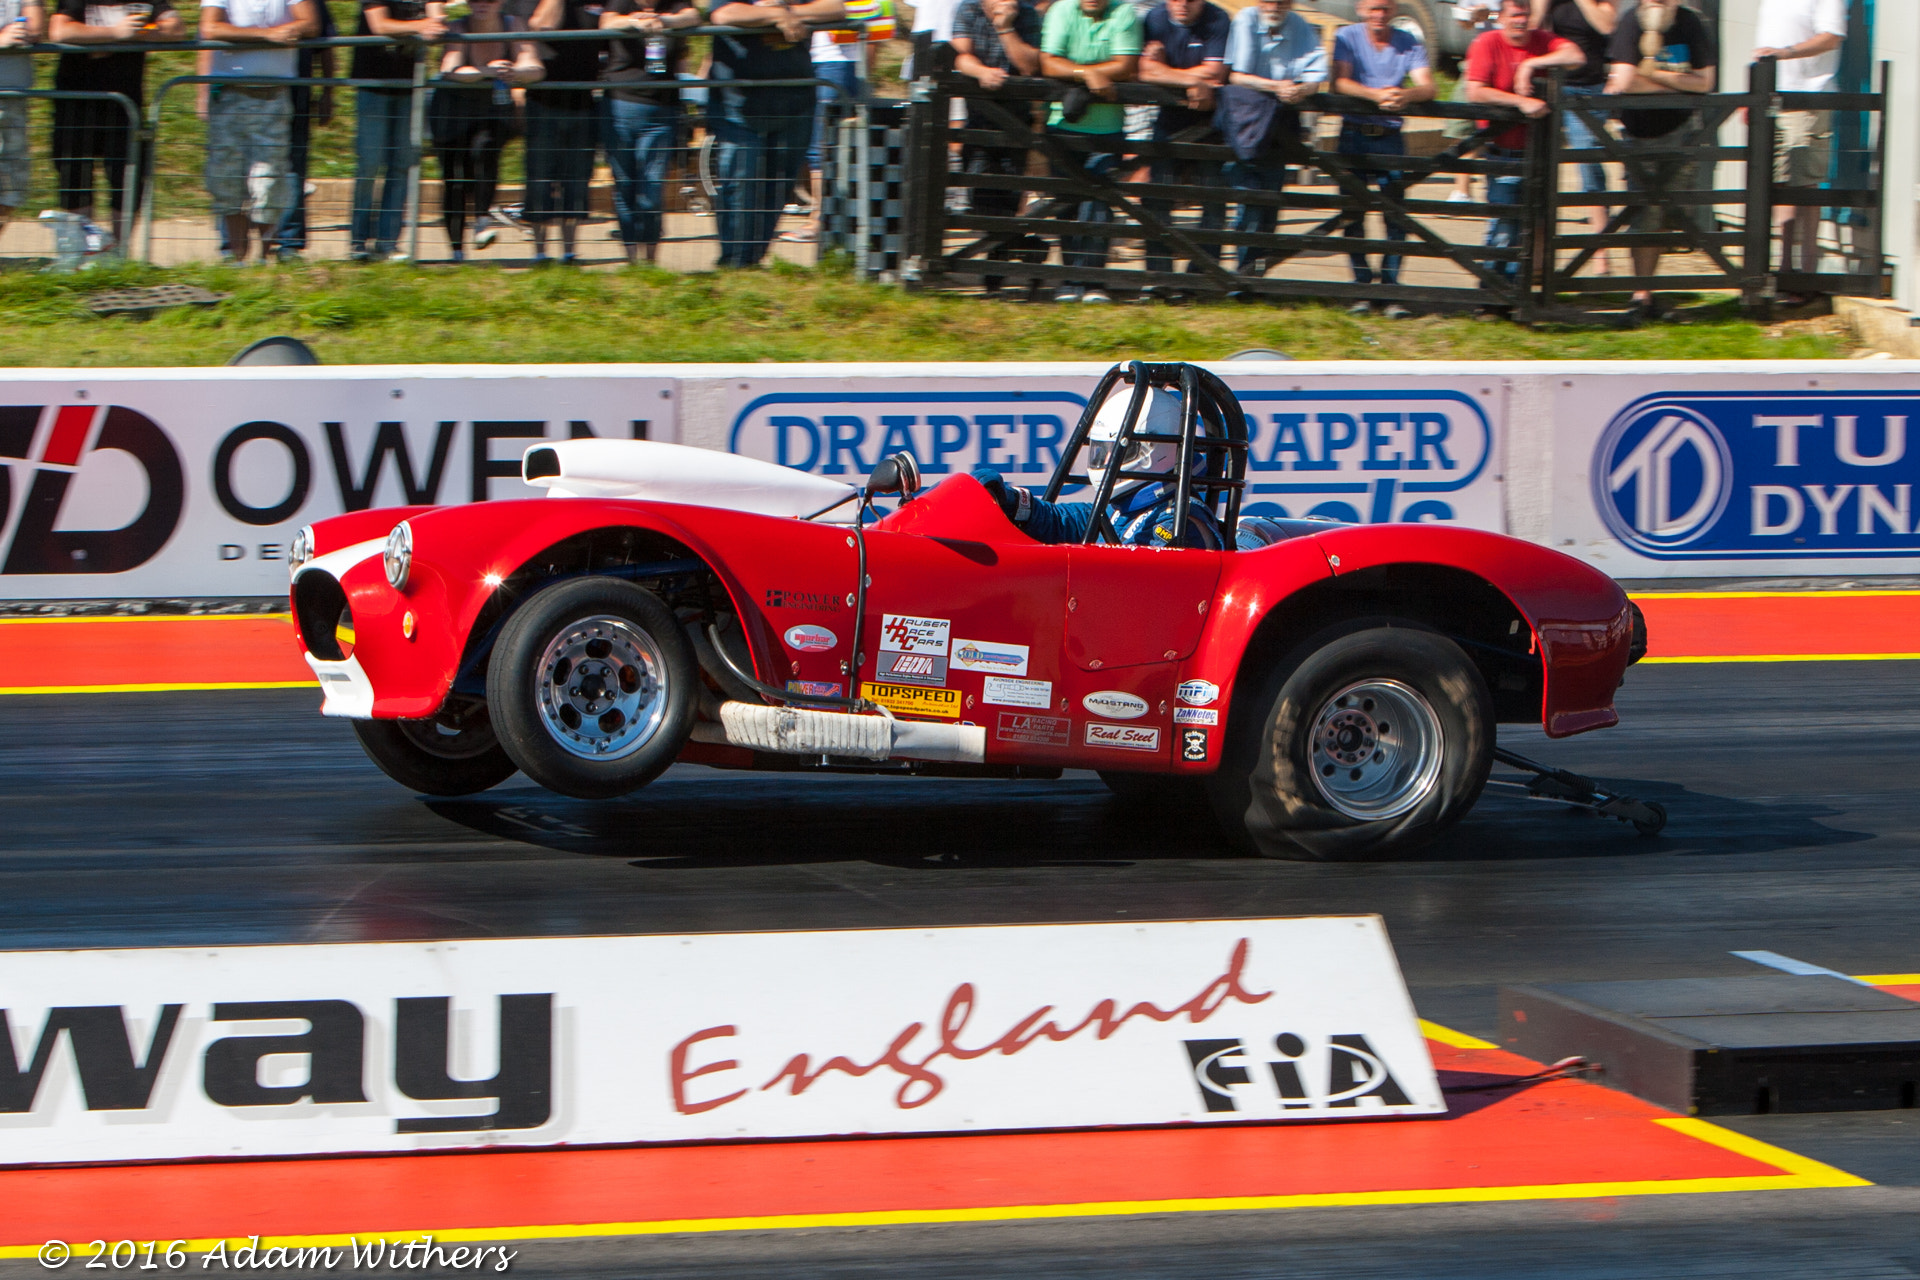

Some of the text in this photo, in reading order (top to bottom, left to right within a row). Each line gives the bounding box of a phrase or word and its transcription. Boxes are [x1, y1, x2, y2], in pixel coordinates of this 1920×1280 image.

[769, 414, 1070, 474] DRAPER
[211, 420, 652, 524] OWE
[783, 591, 840, 606] POWER
[866, 684, 955, 703] TOPSPEED
[1012, 716, 1032, 729] LA
[1090, 726, 1121, 740] Real
[1122, 729, 1156, 743] Steel
[669, 937, 1275, 1115] England
